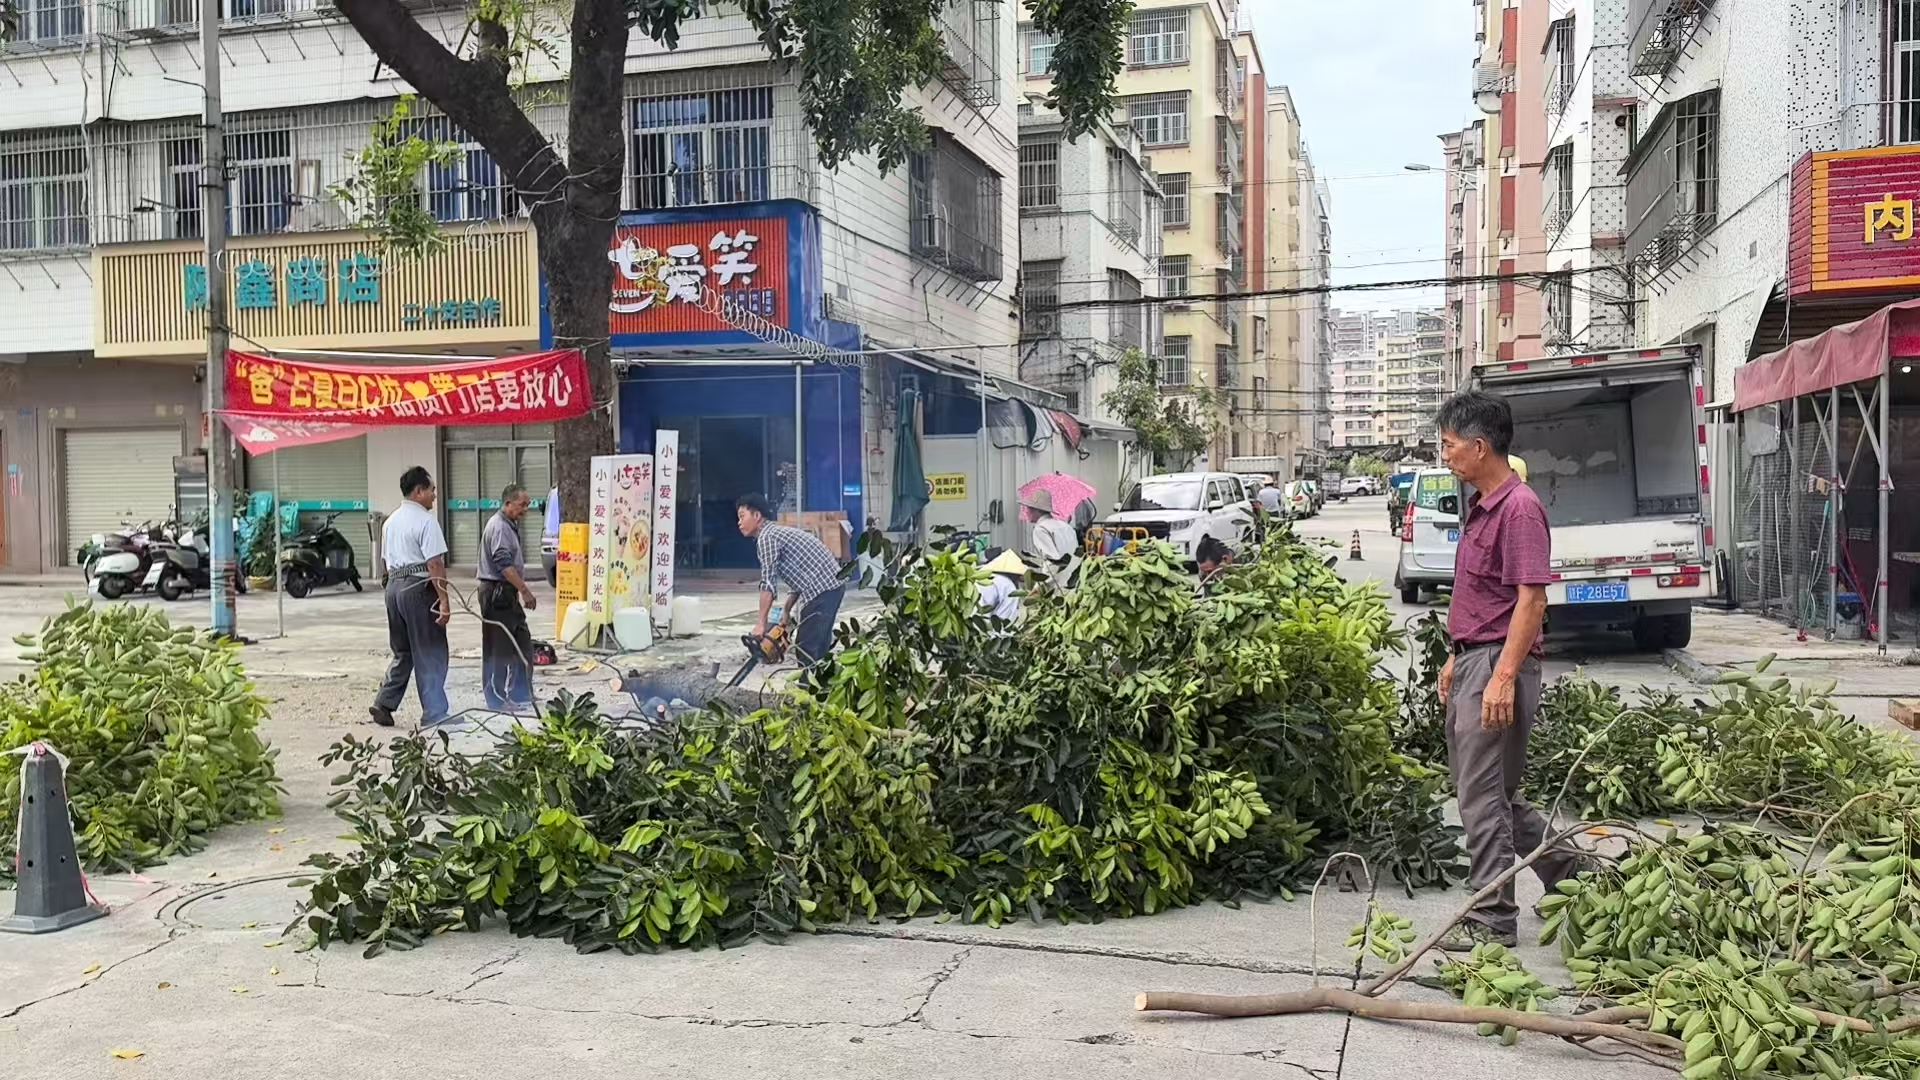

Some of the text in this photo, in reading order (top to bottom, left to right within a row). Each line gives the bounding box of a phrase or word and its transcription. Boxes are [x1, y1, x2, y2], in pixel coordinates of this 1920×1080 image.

[591, 468, 607, 614] 小七爱笑 欢迎光临
[655, 444, 674, 607] 小七爱笑 欢迎光临
